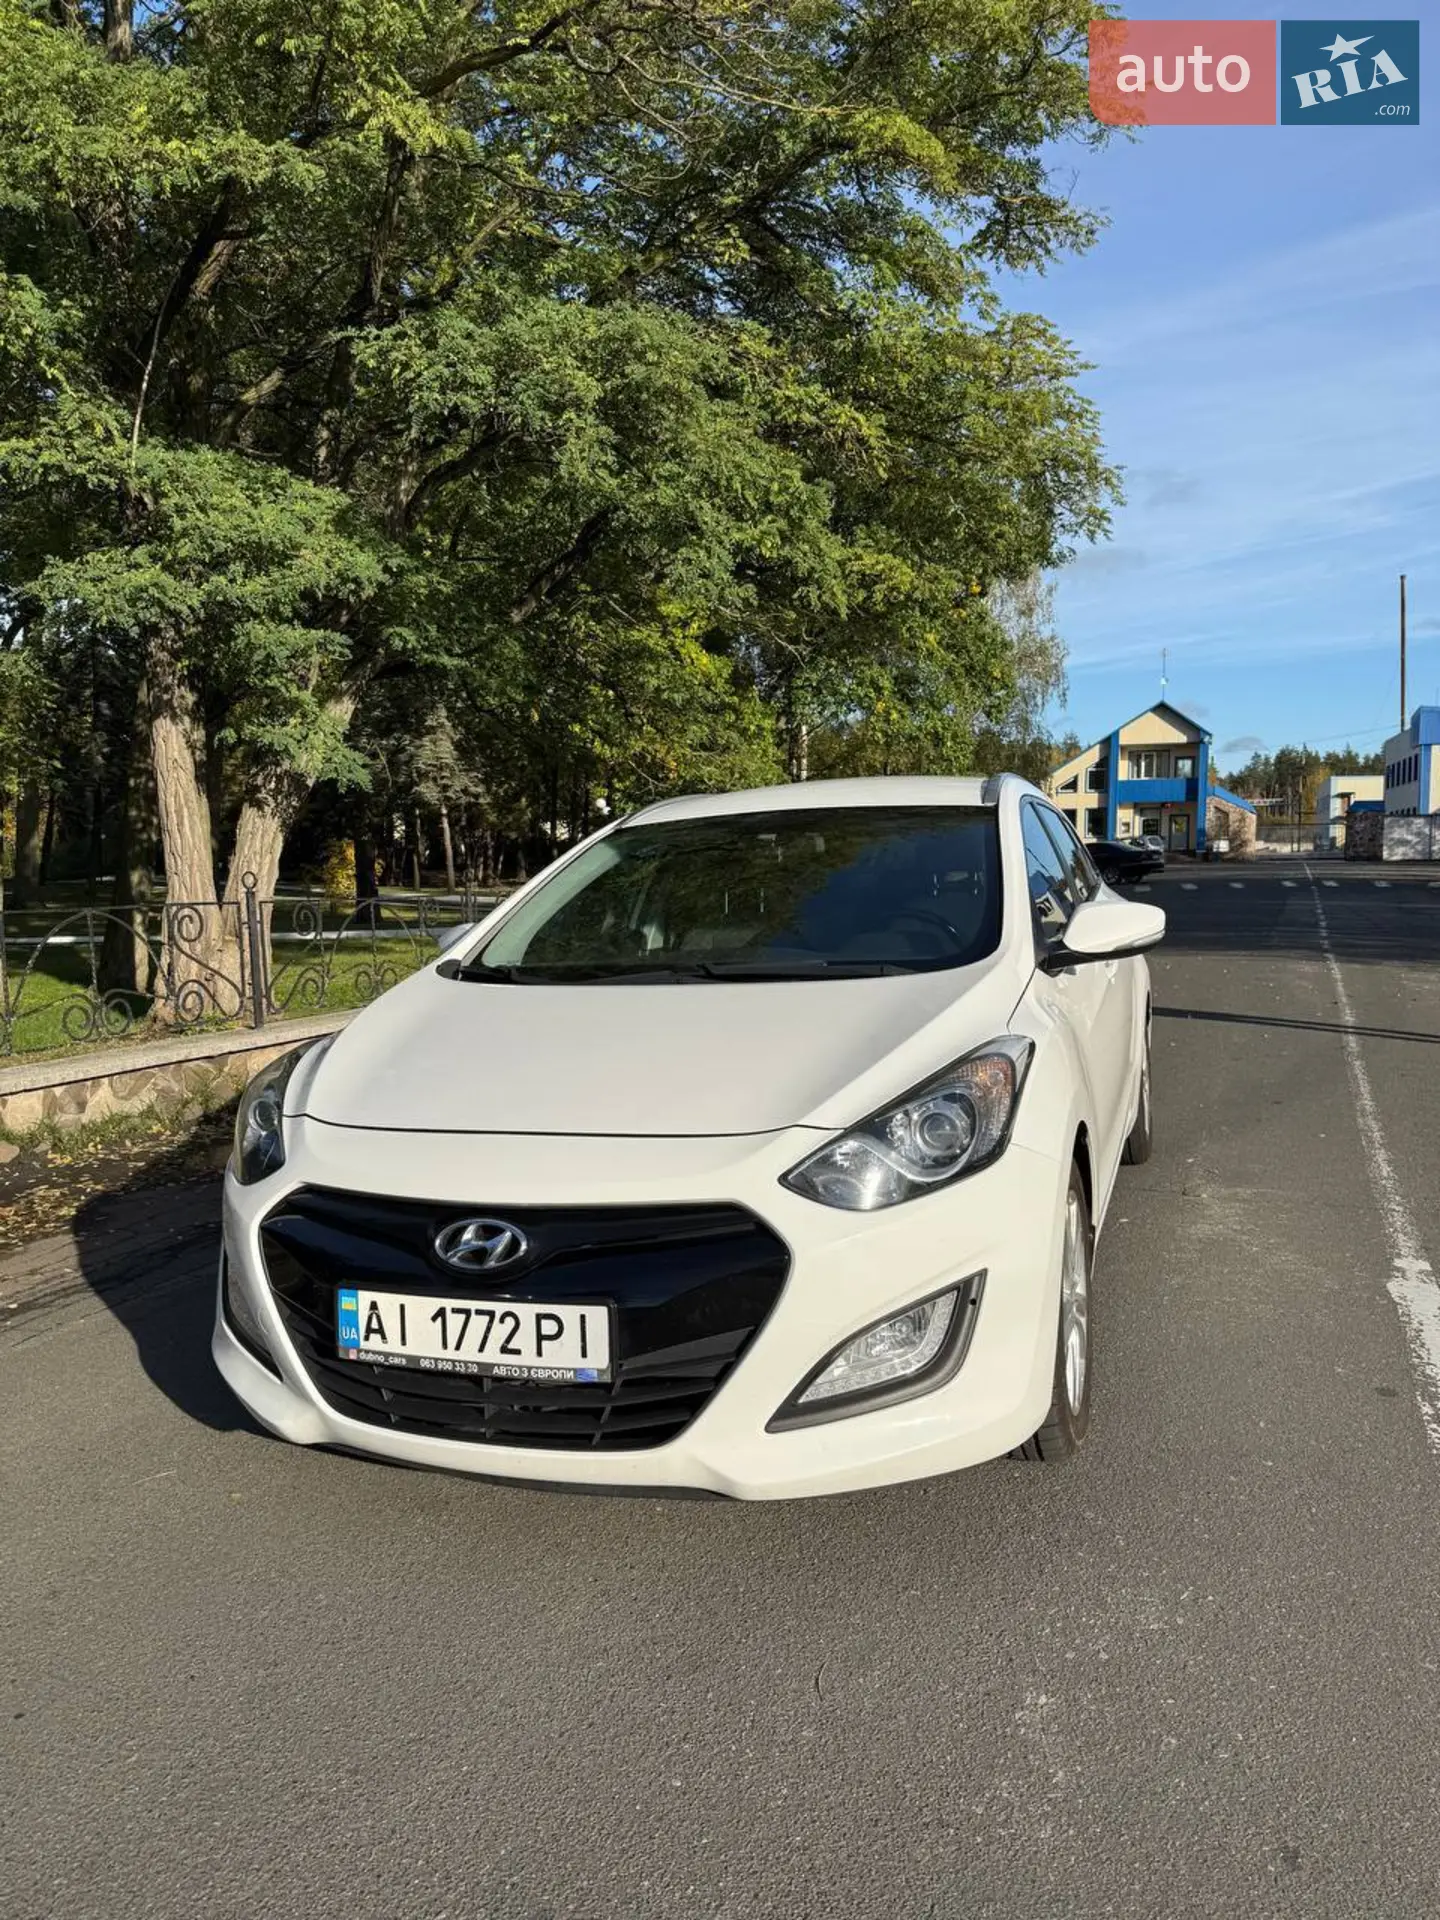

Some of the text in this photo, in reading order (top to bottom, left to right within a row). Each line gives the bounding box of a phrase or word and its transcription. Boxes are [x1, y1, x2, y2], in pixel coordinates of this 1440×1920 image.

[342, 1326, 358, 1341] UA
[363, 1300, 588, 1358] AI 1772 PI
[492, 1365, 520, 1377] АВТО
[530, 1369, 574, 1379] ЄВРОПИ
